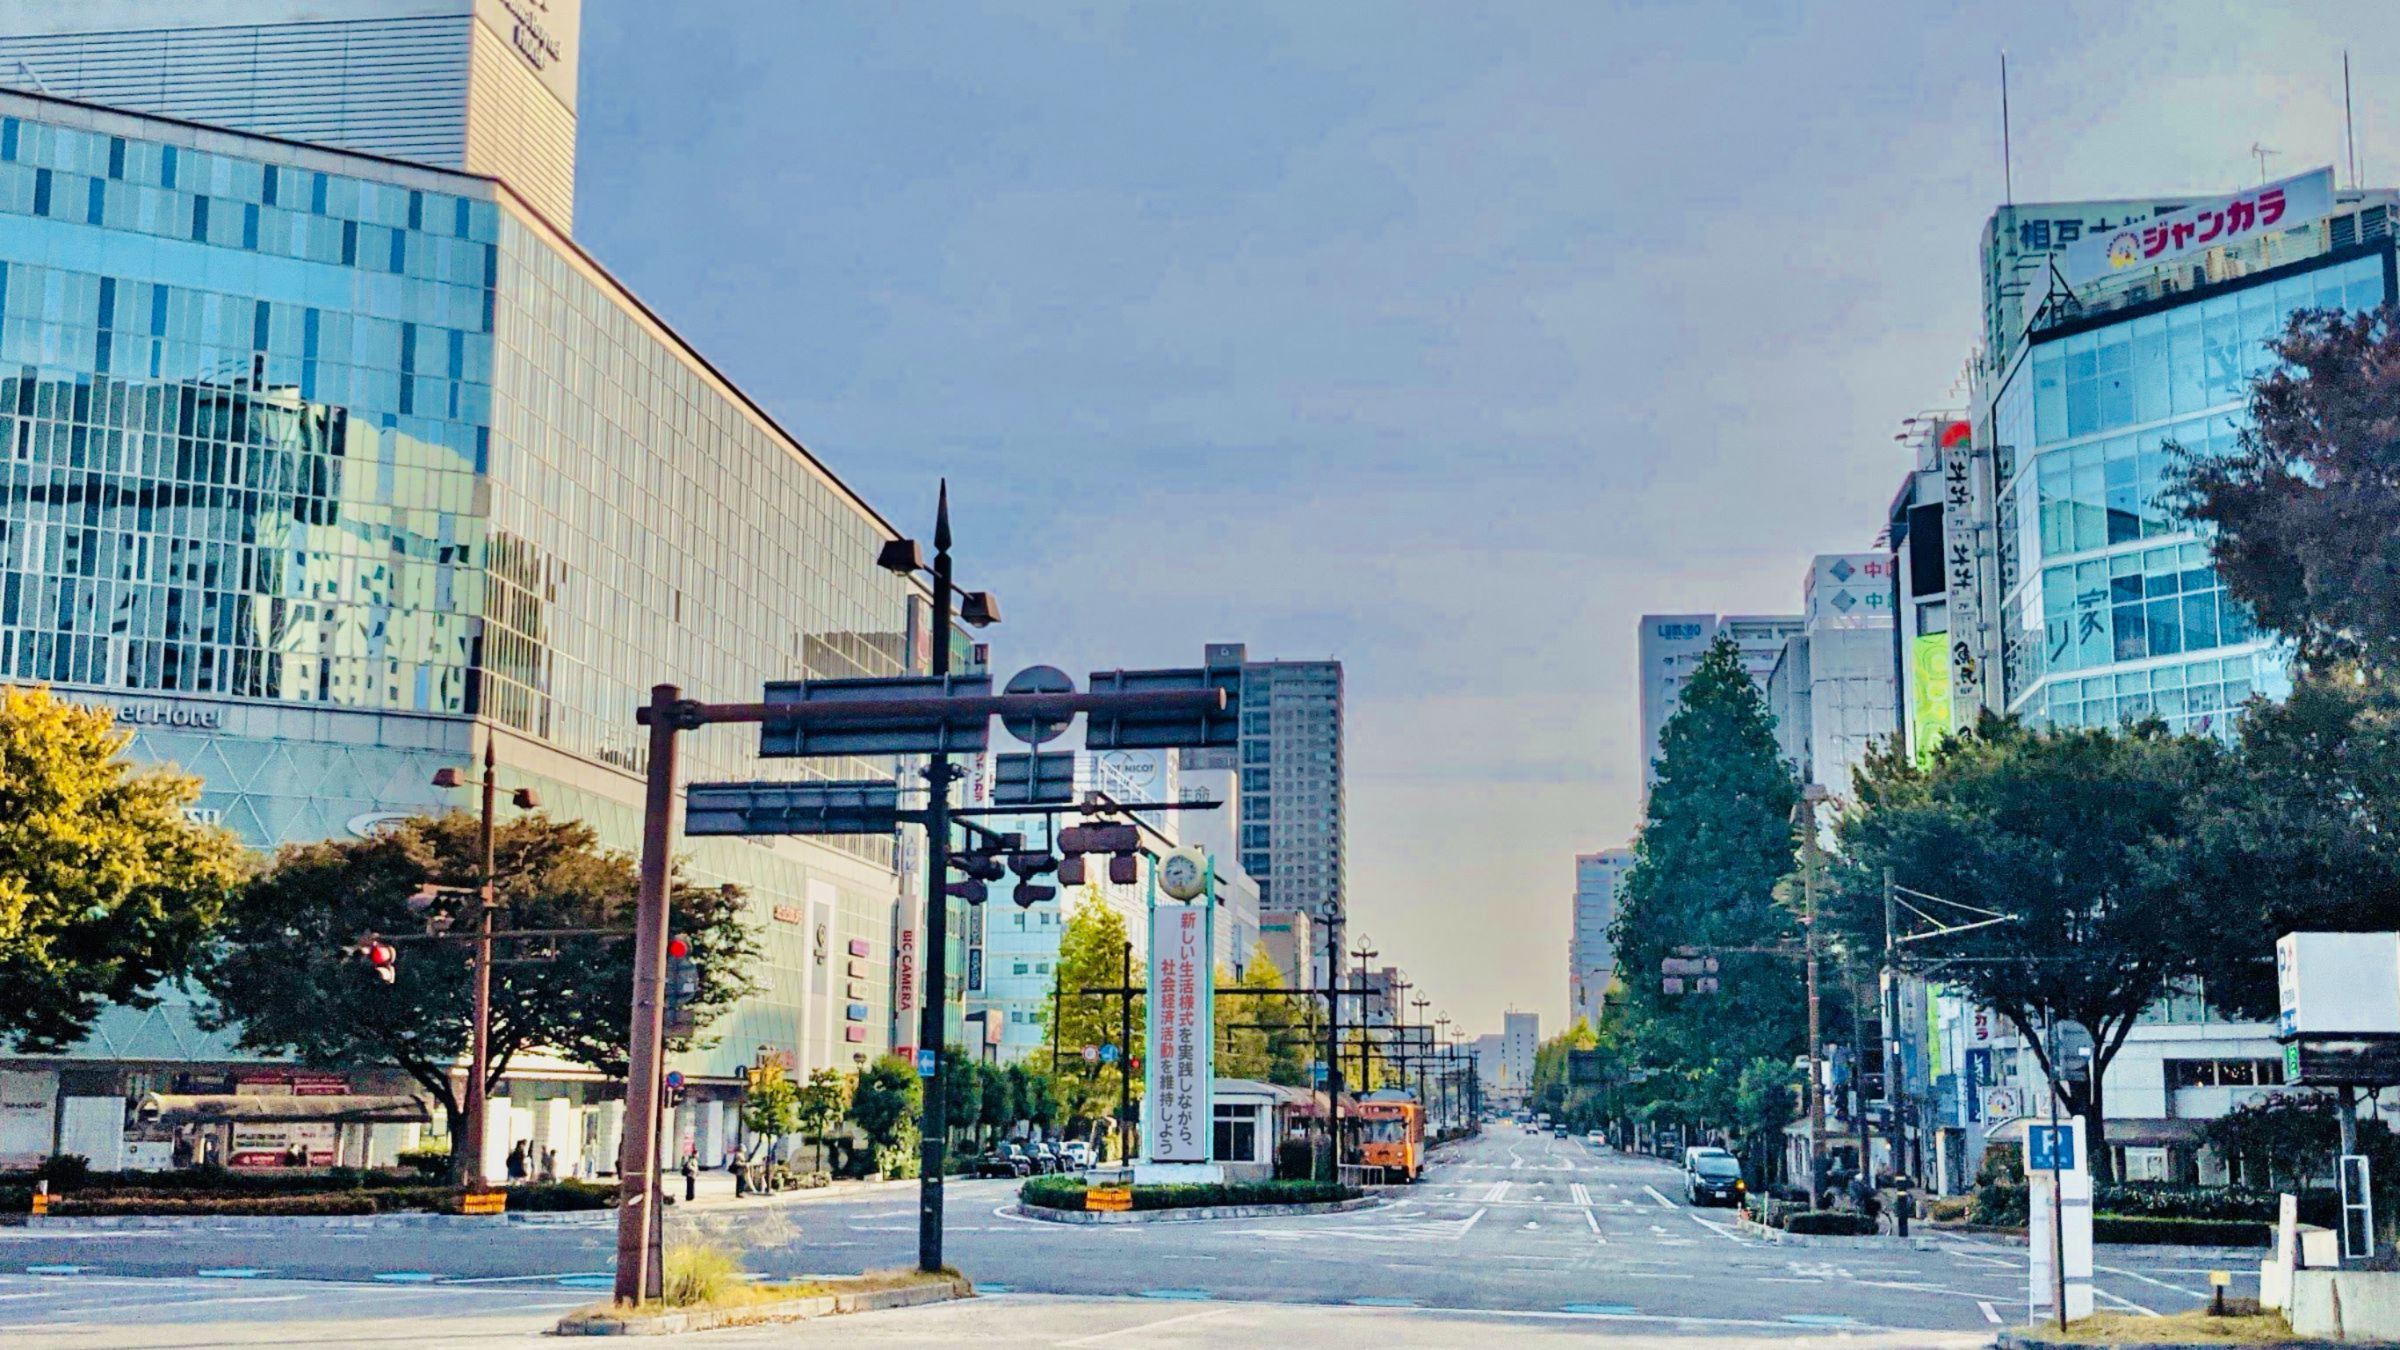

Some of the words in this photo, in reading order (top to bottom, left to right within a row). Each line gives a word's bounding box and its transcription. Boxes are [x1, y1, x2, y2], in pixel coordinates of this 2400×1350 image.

[2143, 189, 2286, 259] ジャンカラ
[153, 704, 222, 728] Hotel
[902, 930, 912, 950] BIC
[900, 954, 912, 1011] CAMERA
[1159, 959, 1176, 1155] 社会経済活動を維持しよう
[1178, 912, 1197, 1146] 新しい生活様式を実践しながら、
[2042, 1129, 2063, 1155] P
